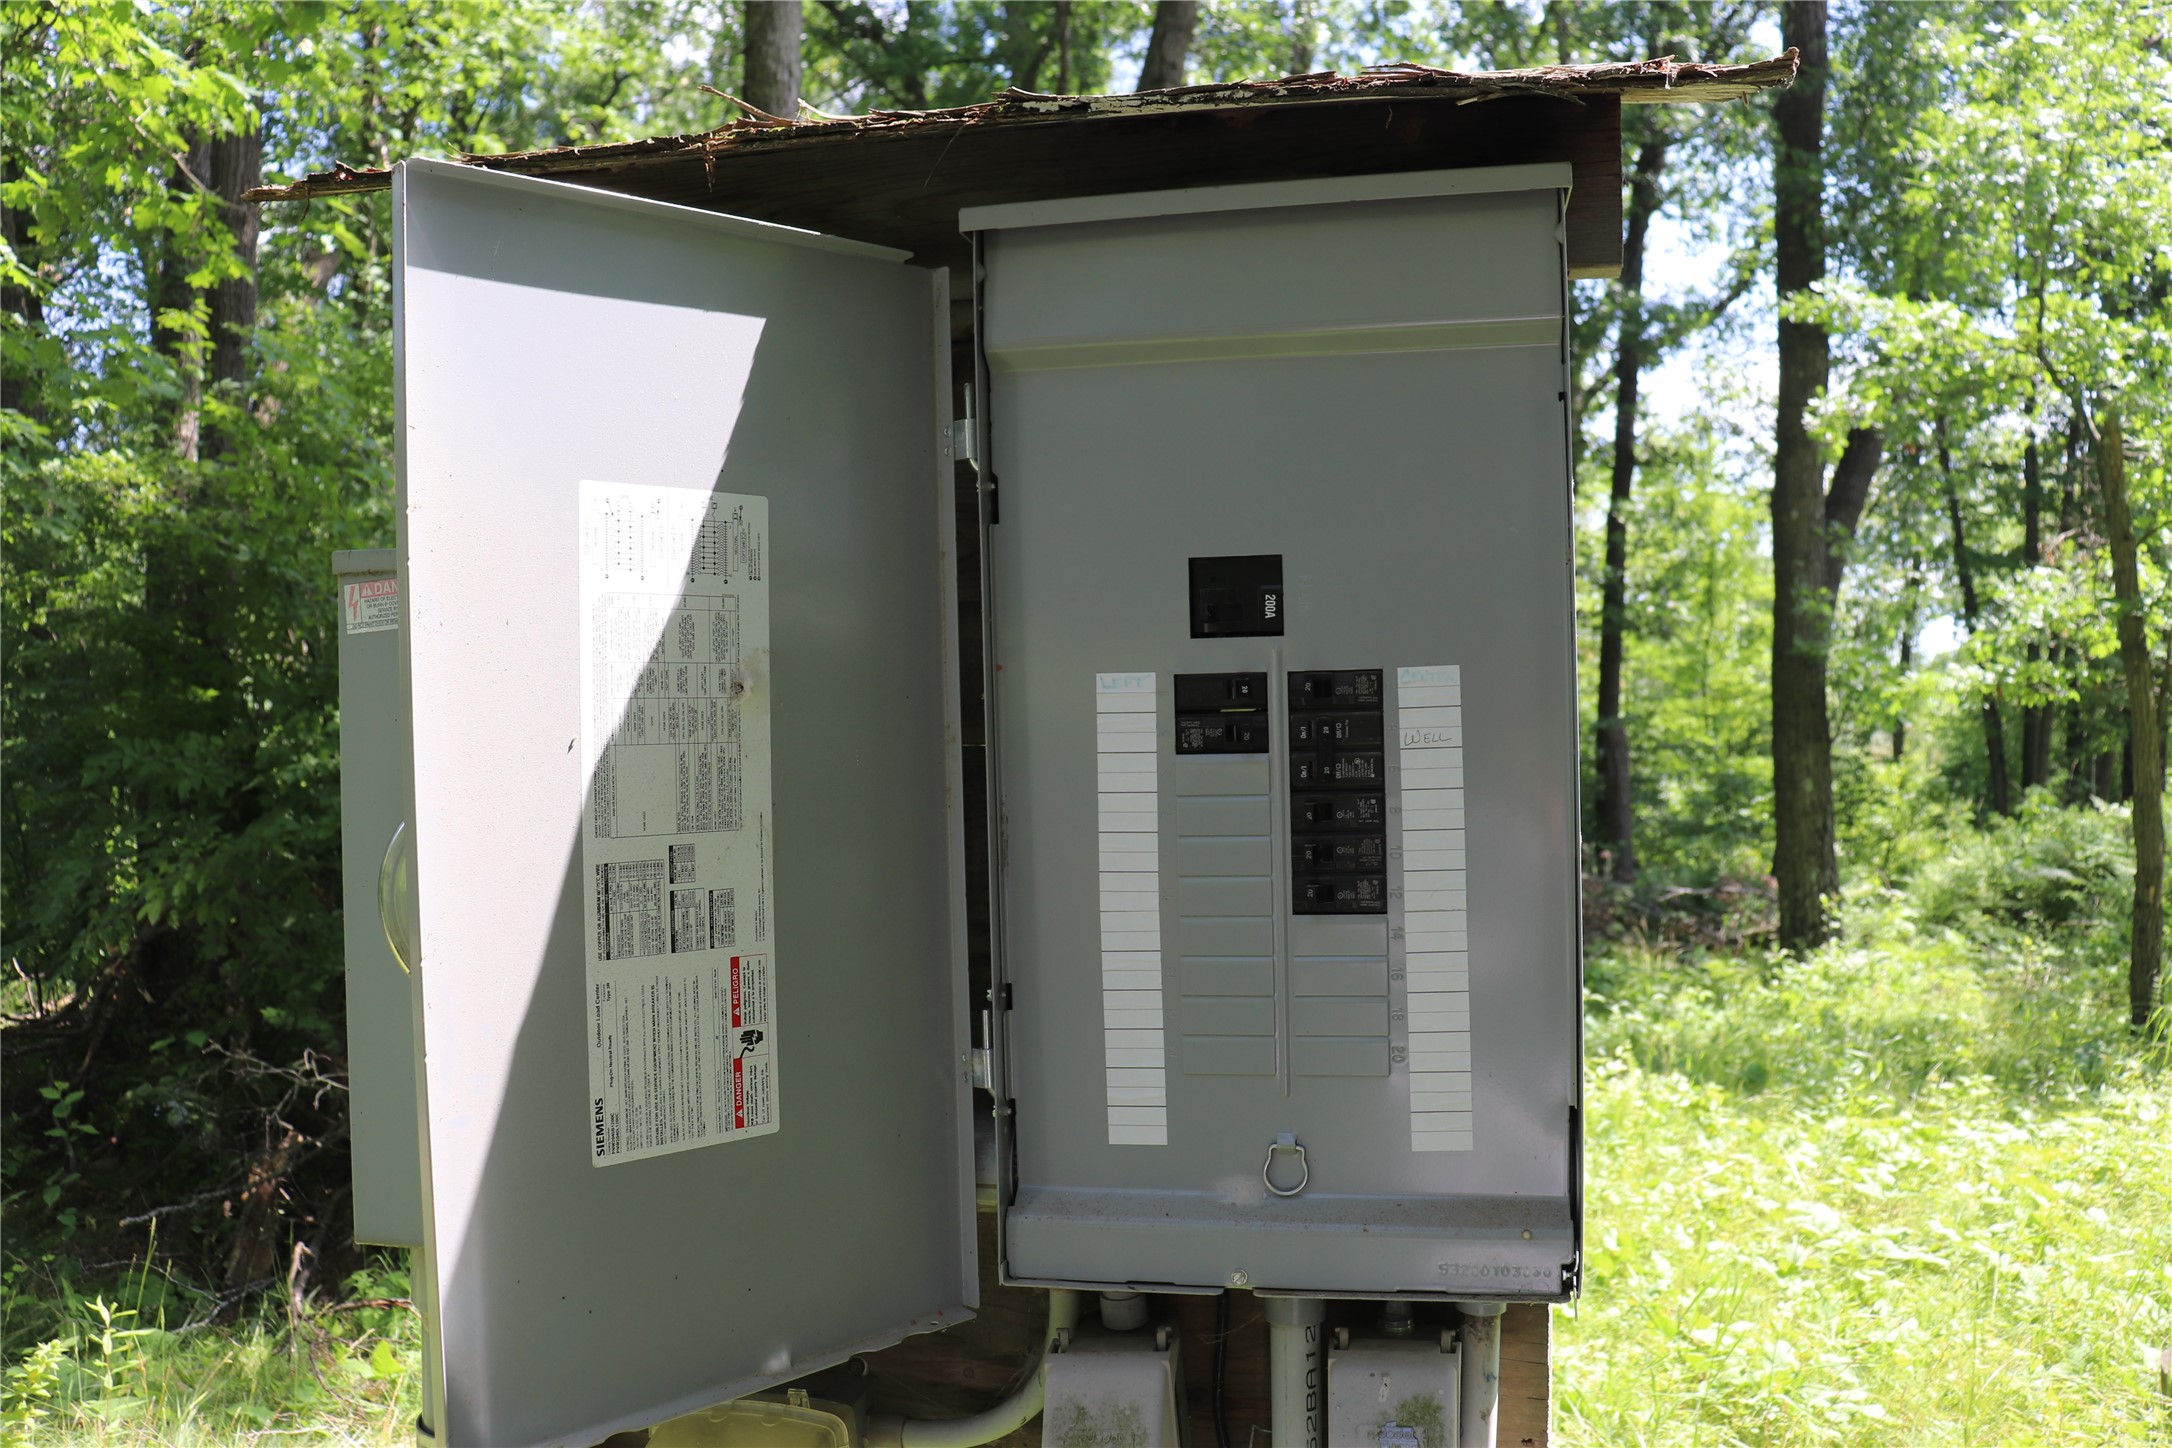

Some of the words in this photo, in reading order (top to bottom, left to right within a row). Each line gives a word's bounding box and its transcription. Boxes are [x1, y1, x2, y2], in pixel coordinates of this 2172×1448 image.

[1265, 594, 1276, 619] 200A
[1100, 674, 1149, 689] LEFT
[1305, 682, 1311, 691] 20
[1241, 685, 1248, 694] 20
[1404, 730, 1452, 746] WELL
[1390, 806, 1401, 815] 8
[1306, 850, 1312, 859] 20
[1390, 844, 1402, 860] 10
[1390, 886, 1402, 900] 12
[1391, 926, 1405, 940] 14
[1391, 967, 1404, 981] 16
[1392, 1007, 1404, 1021] 18
[1392, 1046, 1407, 1064] 20
[595, 1098, 605, 1156] SIEMENS
